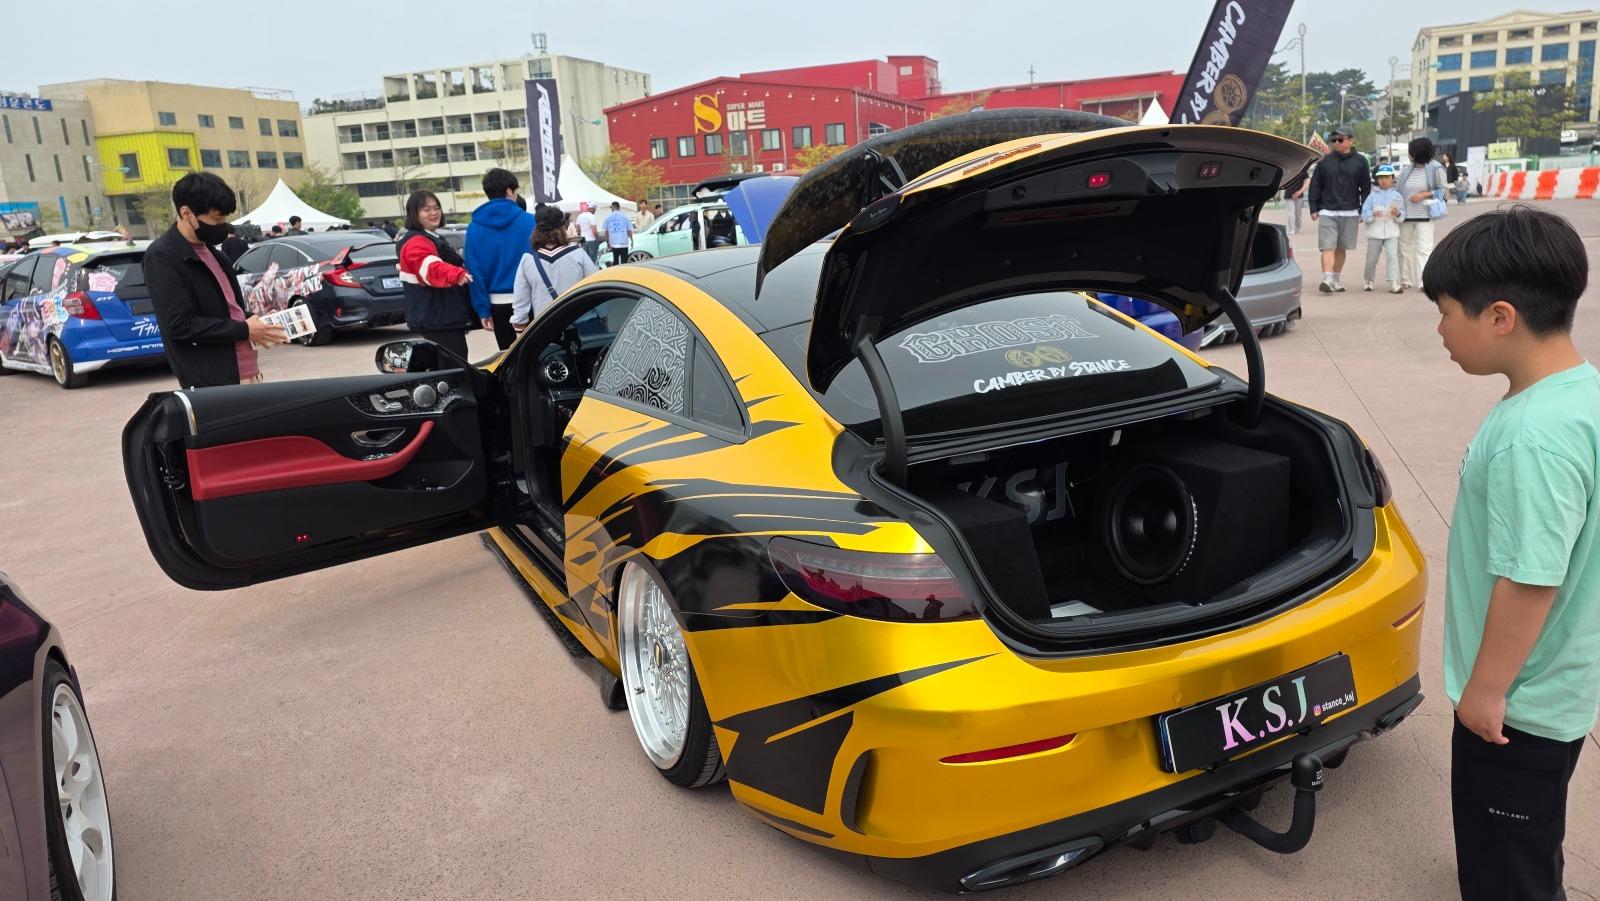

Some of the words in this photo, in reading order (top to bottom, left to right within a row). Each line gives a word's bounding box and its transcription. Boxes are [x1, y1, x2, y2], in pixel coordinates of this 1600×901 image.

[1196, 1, 1245, 94] CAMBER
[694, 95, 722, 134] S
[727, 109, 766, 131] 마트
[748, 101, 765, 109] MART
[1190, 92, 1208, 120] BY
[536, 82, 556, 200] REMAKE
[974, 368, 1051, 394] CAMBER
[1048, 366, 1065, 377] BY
[1069, 359, 1131, 377] STANCE
[1216, 676, 1308, 750] K.S.J
[1322, 691, 1355, 712] stance_ksj
